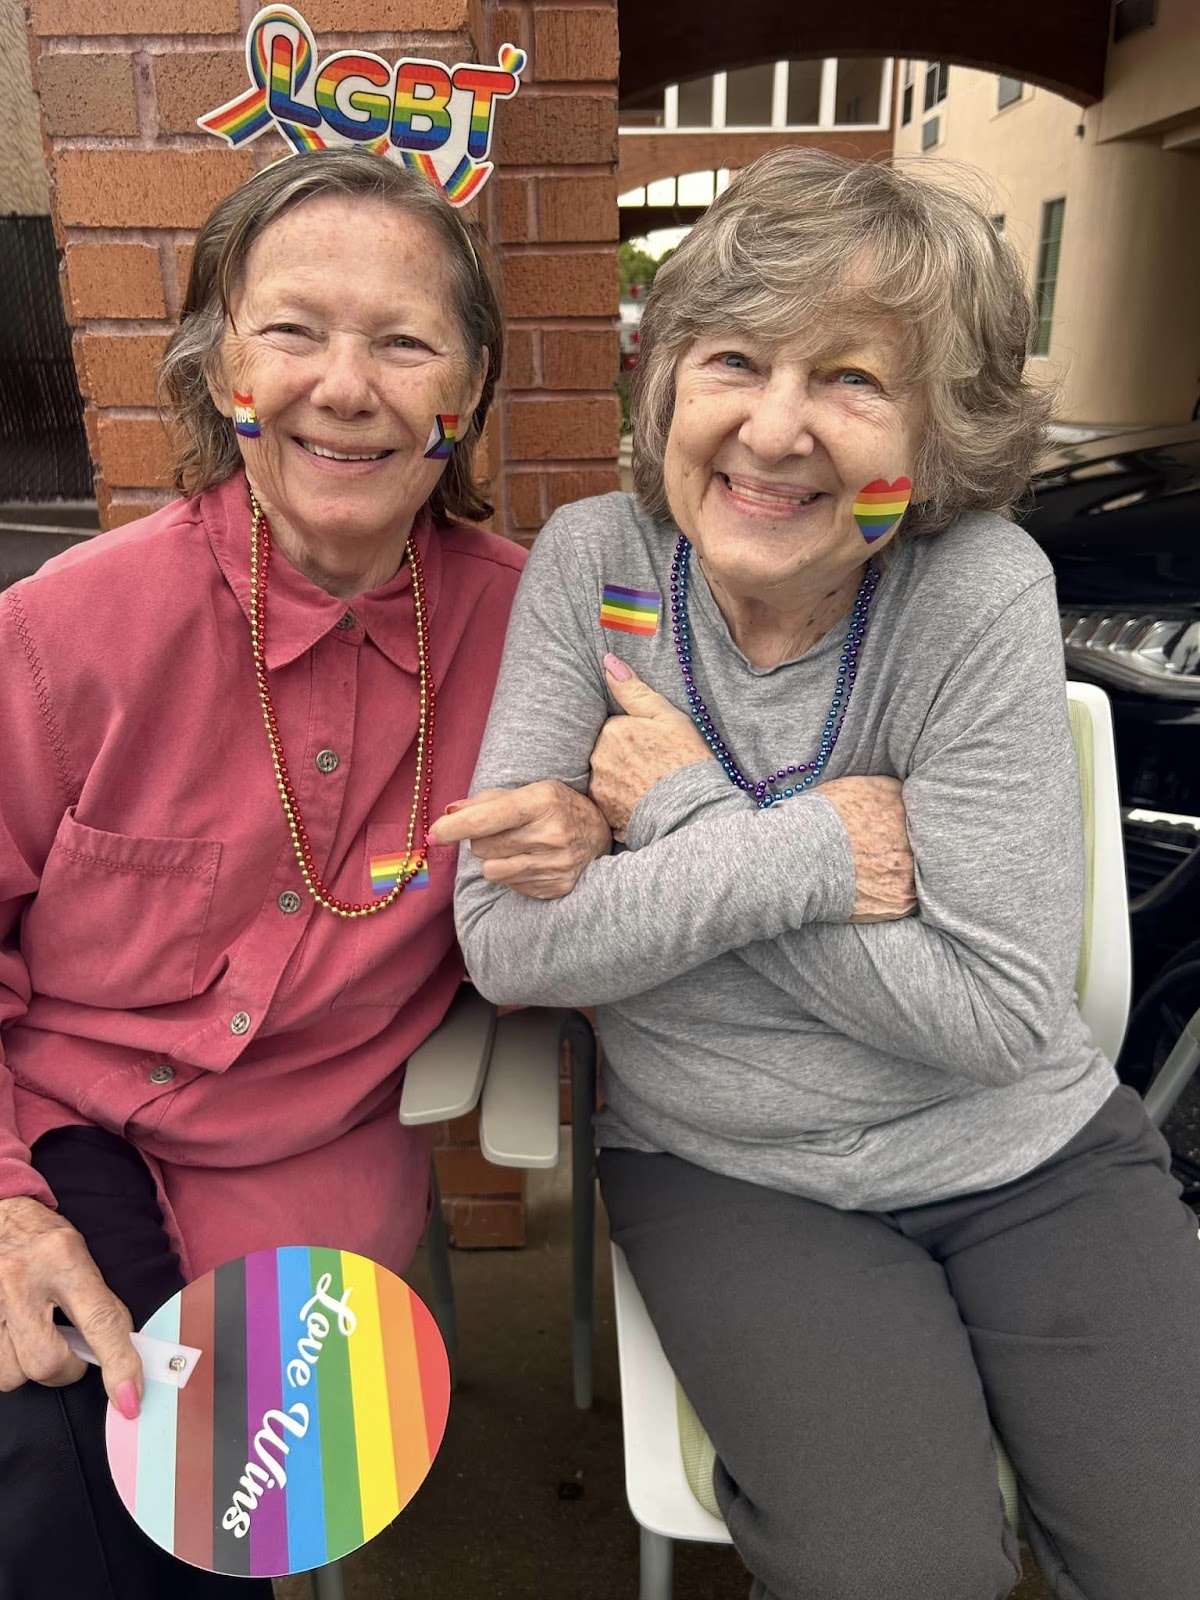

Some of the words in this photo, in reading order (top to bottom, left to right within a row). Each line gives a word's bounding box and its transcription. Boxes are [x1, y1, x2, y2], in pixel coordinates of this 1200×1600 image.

[269, 35, 516, 159] LGBT
[287, 1273, 357, 1387] Love
[222, 1403, 310, 1538] Wins
